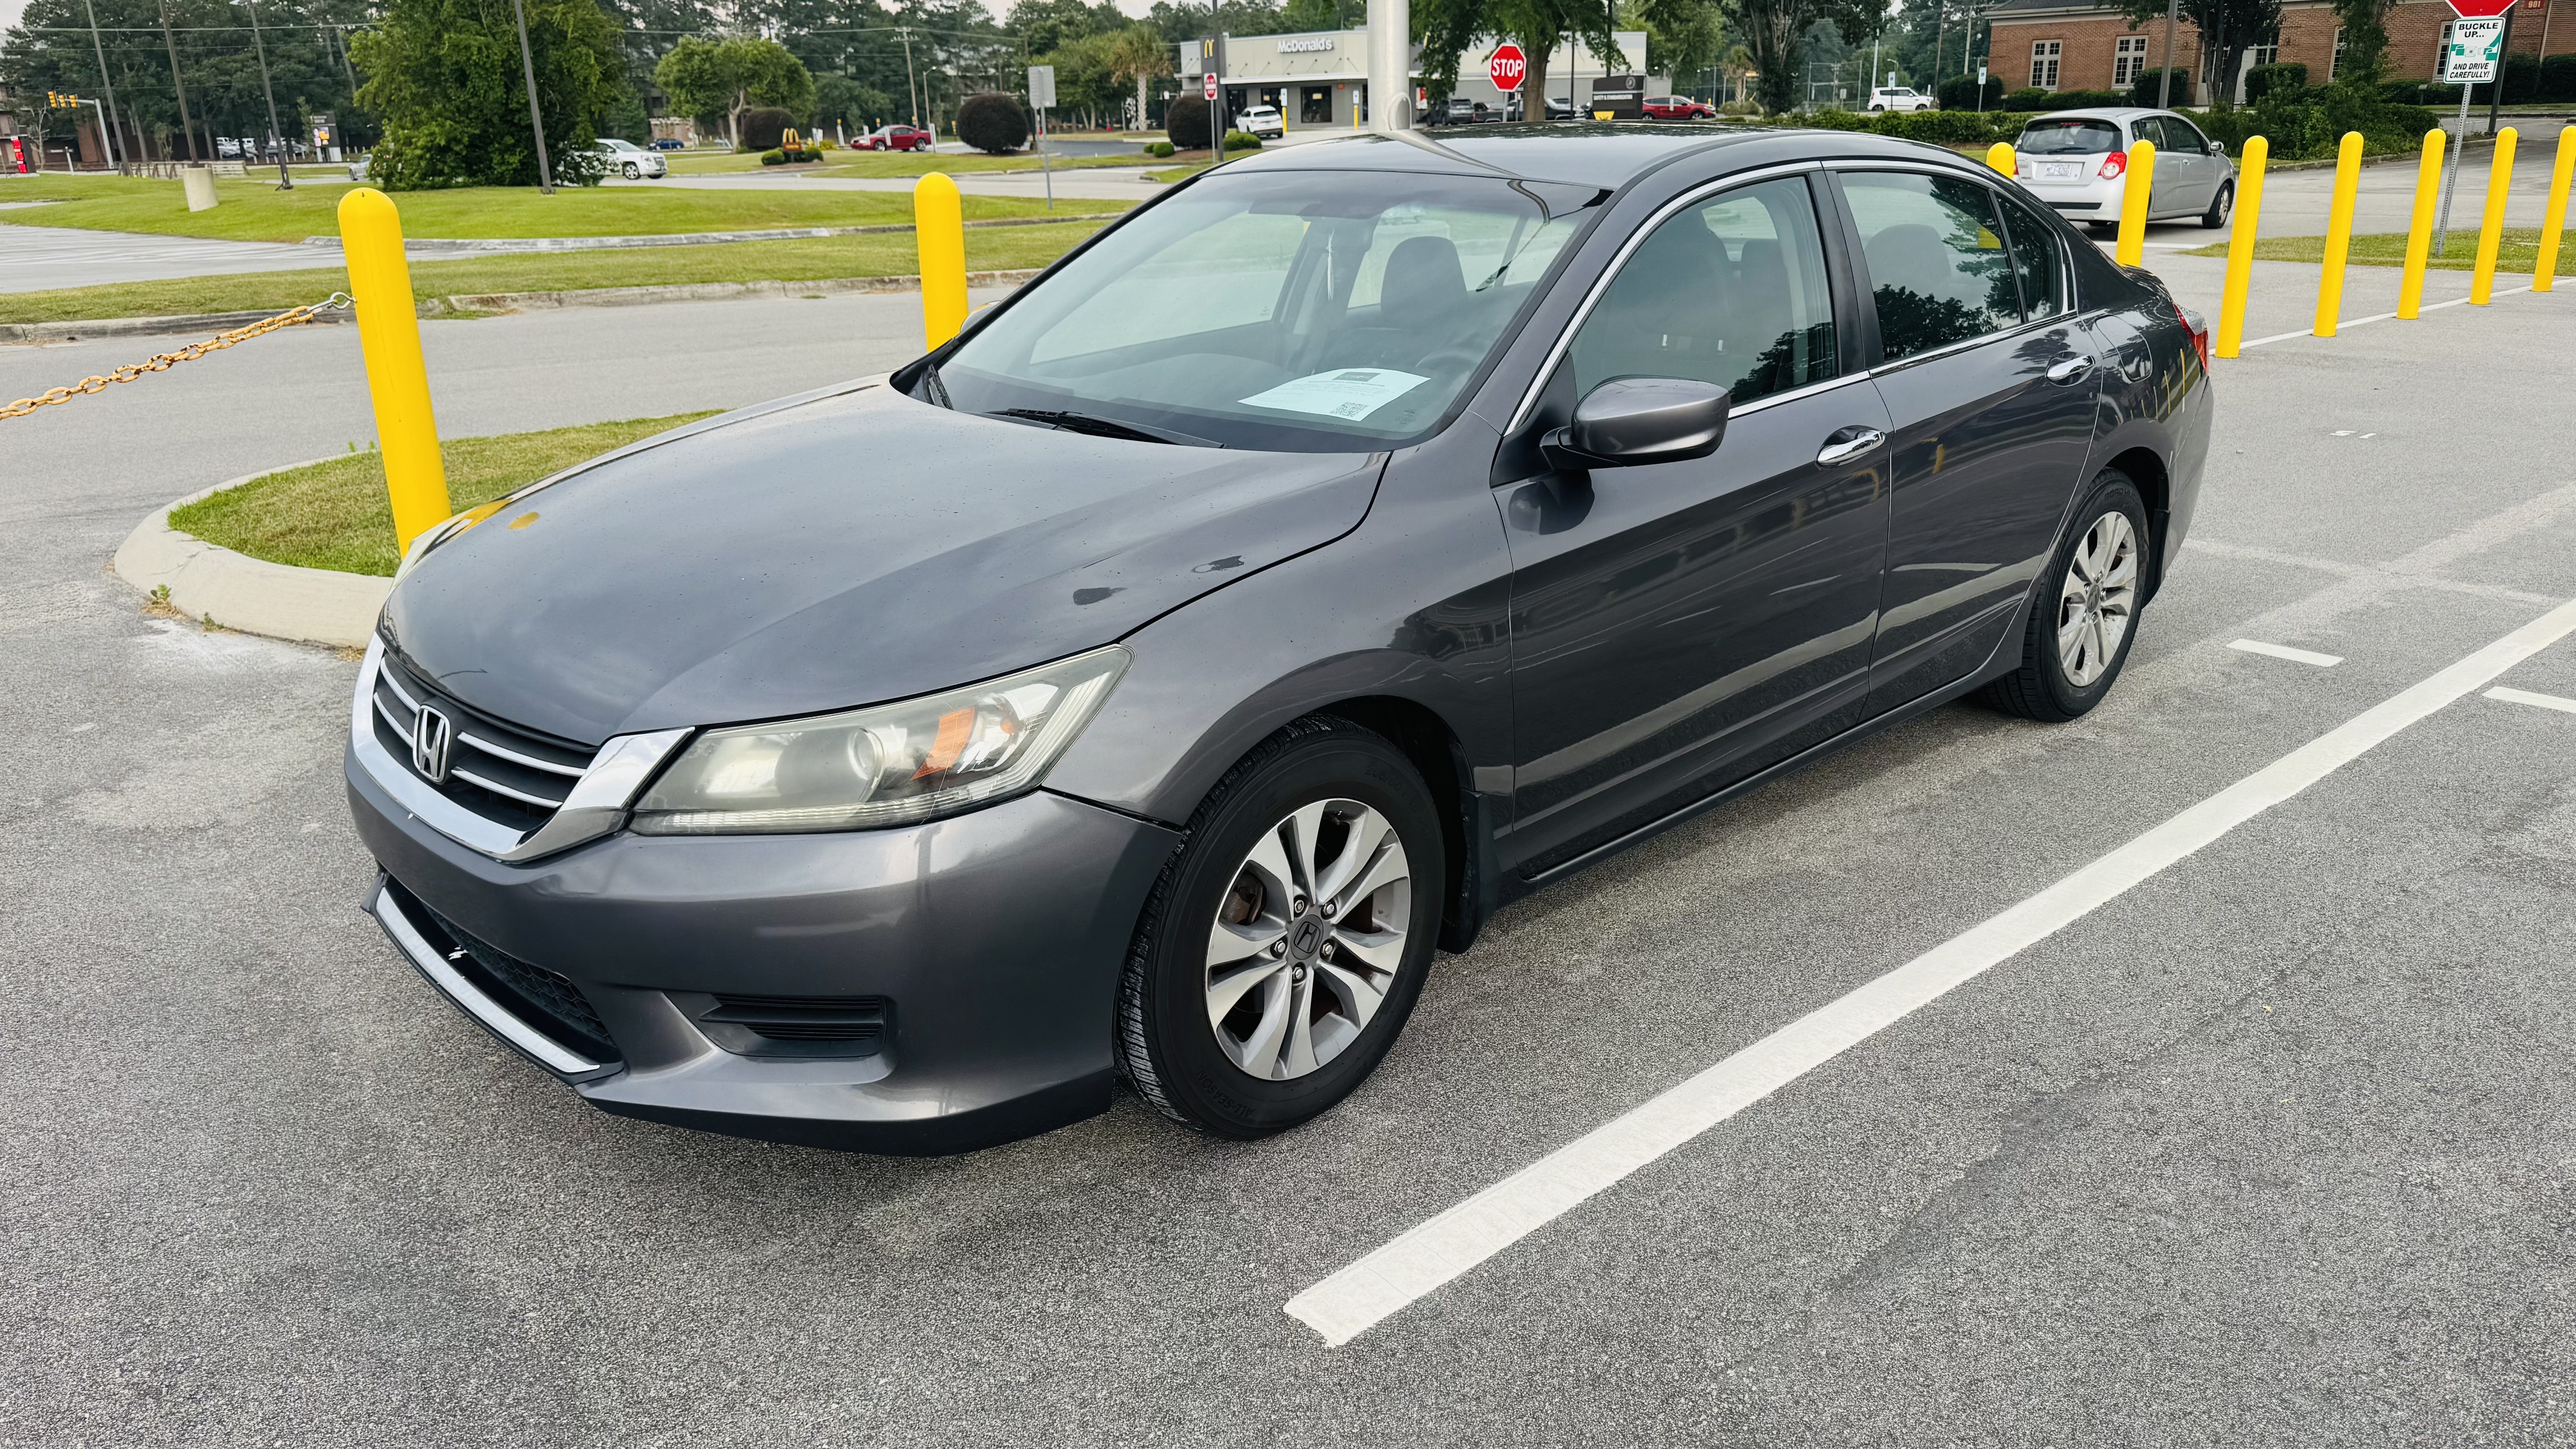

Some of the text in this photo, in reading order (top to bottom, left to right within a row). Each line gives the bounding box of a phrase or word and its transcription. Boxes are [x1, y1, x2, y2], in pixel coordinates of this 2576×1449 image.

[1277, 38, 1333, 53] McDonald's
[1492, 59, 1523, 77] STOP
[1195, 1068, 1256, 1117] ALL-SEASON
